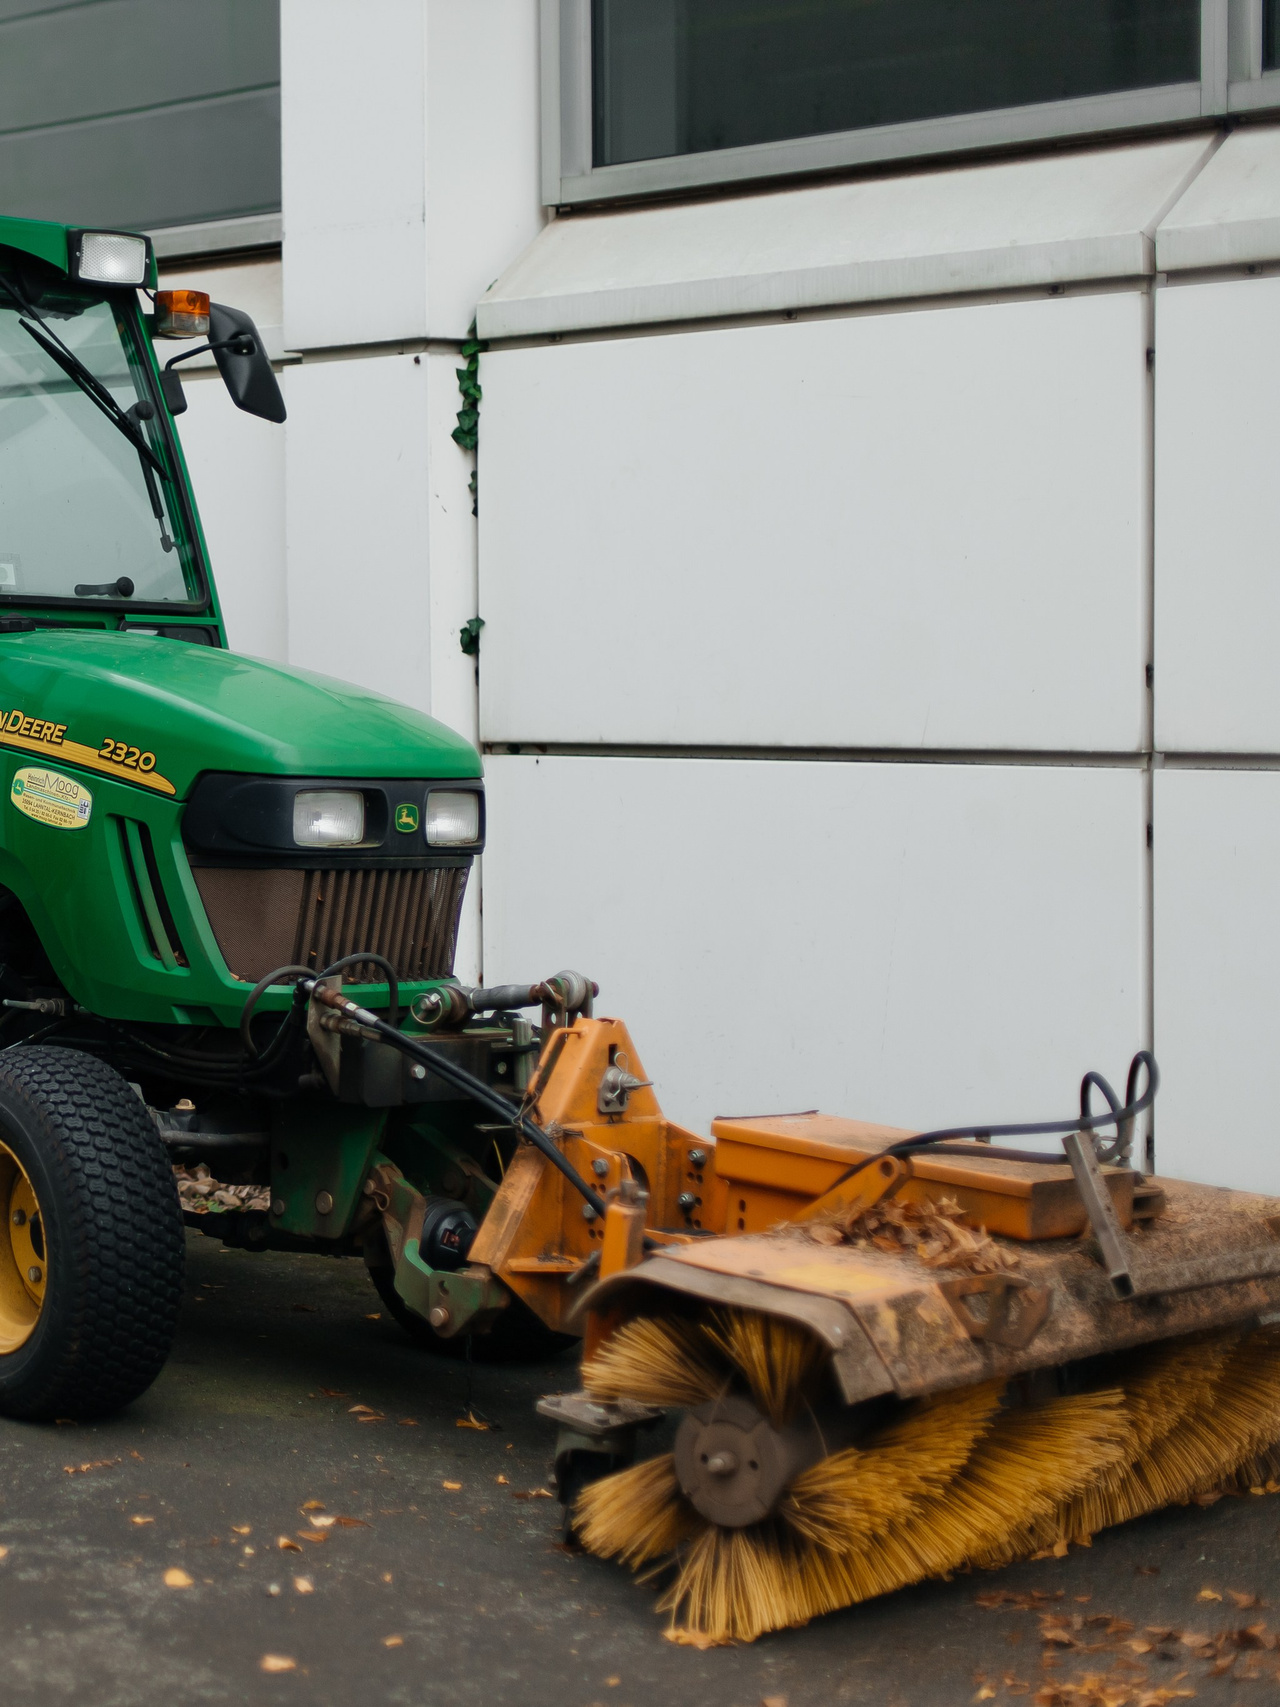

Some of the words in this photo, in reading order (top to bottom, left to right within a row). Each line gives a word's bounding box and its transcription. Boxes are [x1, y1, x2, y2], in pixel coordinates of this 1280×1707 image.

[5, 709, 68, 745] DEERE
[99, 738, 156, 772] 2320
[44, 773, 80, 799] Moog
